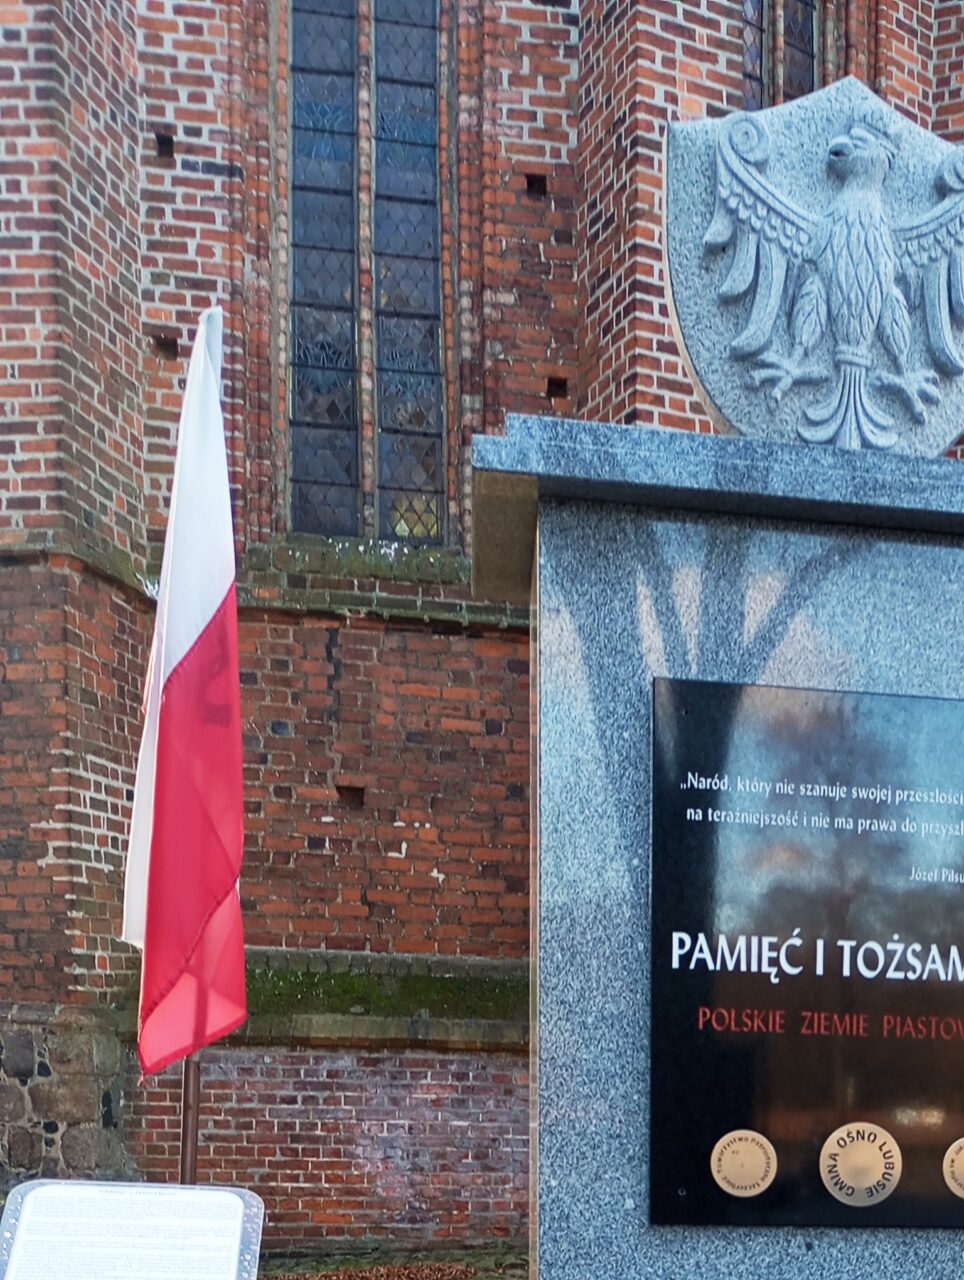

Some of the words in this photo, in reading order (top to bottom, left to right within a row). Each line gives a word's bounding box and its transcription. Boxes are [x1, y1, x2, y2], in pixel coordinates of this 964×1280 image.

[737, 776, 772, 798] który
[776, 778, 795, 795] nie
[800, 782, 847, 802] szanuje
[851, 784, 892, 804] swojej
[686, 807, 703, 821] na
[803, 812, 807, 827] i
[811, 812, 830, 828] nie
[834, 817, 853, 830] ma
[857, 817, 897, 834] prawa
[901, 817, 917, 832] do
[909, 867, 938, 882] Józef
[671, 927, 804, 984] PAMIĘĆ
[815, 938, 824, 976] I
[698, 1007, 786, 1033] POLSKIE
[801, 1011, 869, 1037] ZIEMIE
[836, 1128, 878, 1149] OŚNO
[827, 1152, 855, 1197] GMINA
[865, 1141, 895, 1198] LUBUSIE
